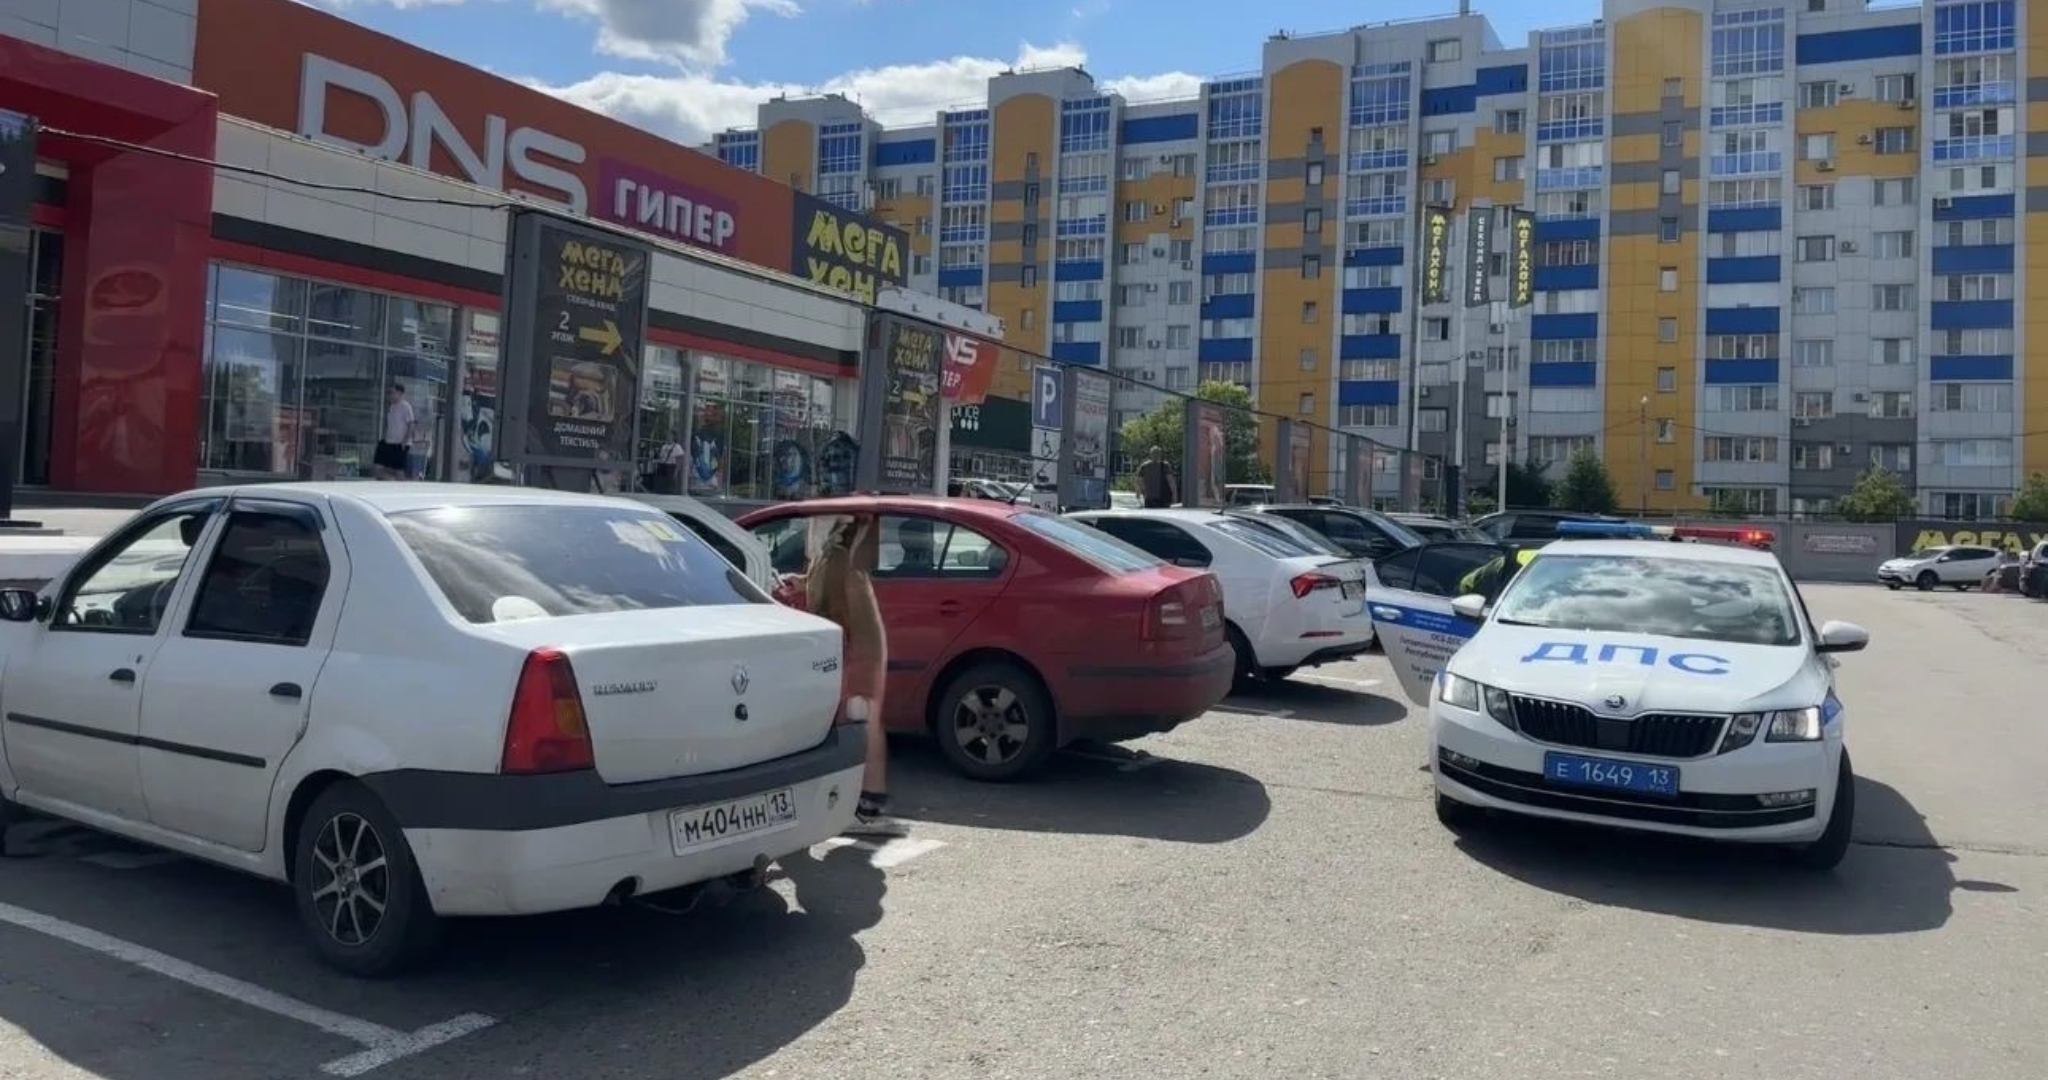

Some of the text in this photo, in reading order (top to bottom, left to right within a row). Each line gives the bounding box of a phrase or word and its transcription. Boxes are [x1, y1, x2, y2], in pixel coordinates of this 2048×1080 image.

[298, 52, 589, 217] DNS
[614, 178, 735, 247] ГИПЕР
[559, 310, 571, 331] 2
[892, 380, 900, 395] 2
[1041, 374, 1056, 420] P
[553, 421, 607, 437] ДОМАШНИЙ
[560, 435, 600, 449] ТЕКСТИЛЬ
[1521, 642, 1731, 675] ДПС
[1580, 761, 1634, 786] 1649
[1648, 769, 1669, 785] 13
[771, 793, 788, 814] 13
